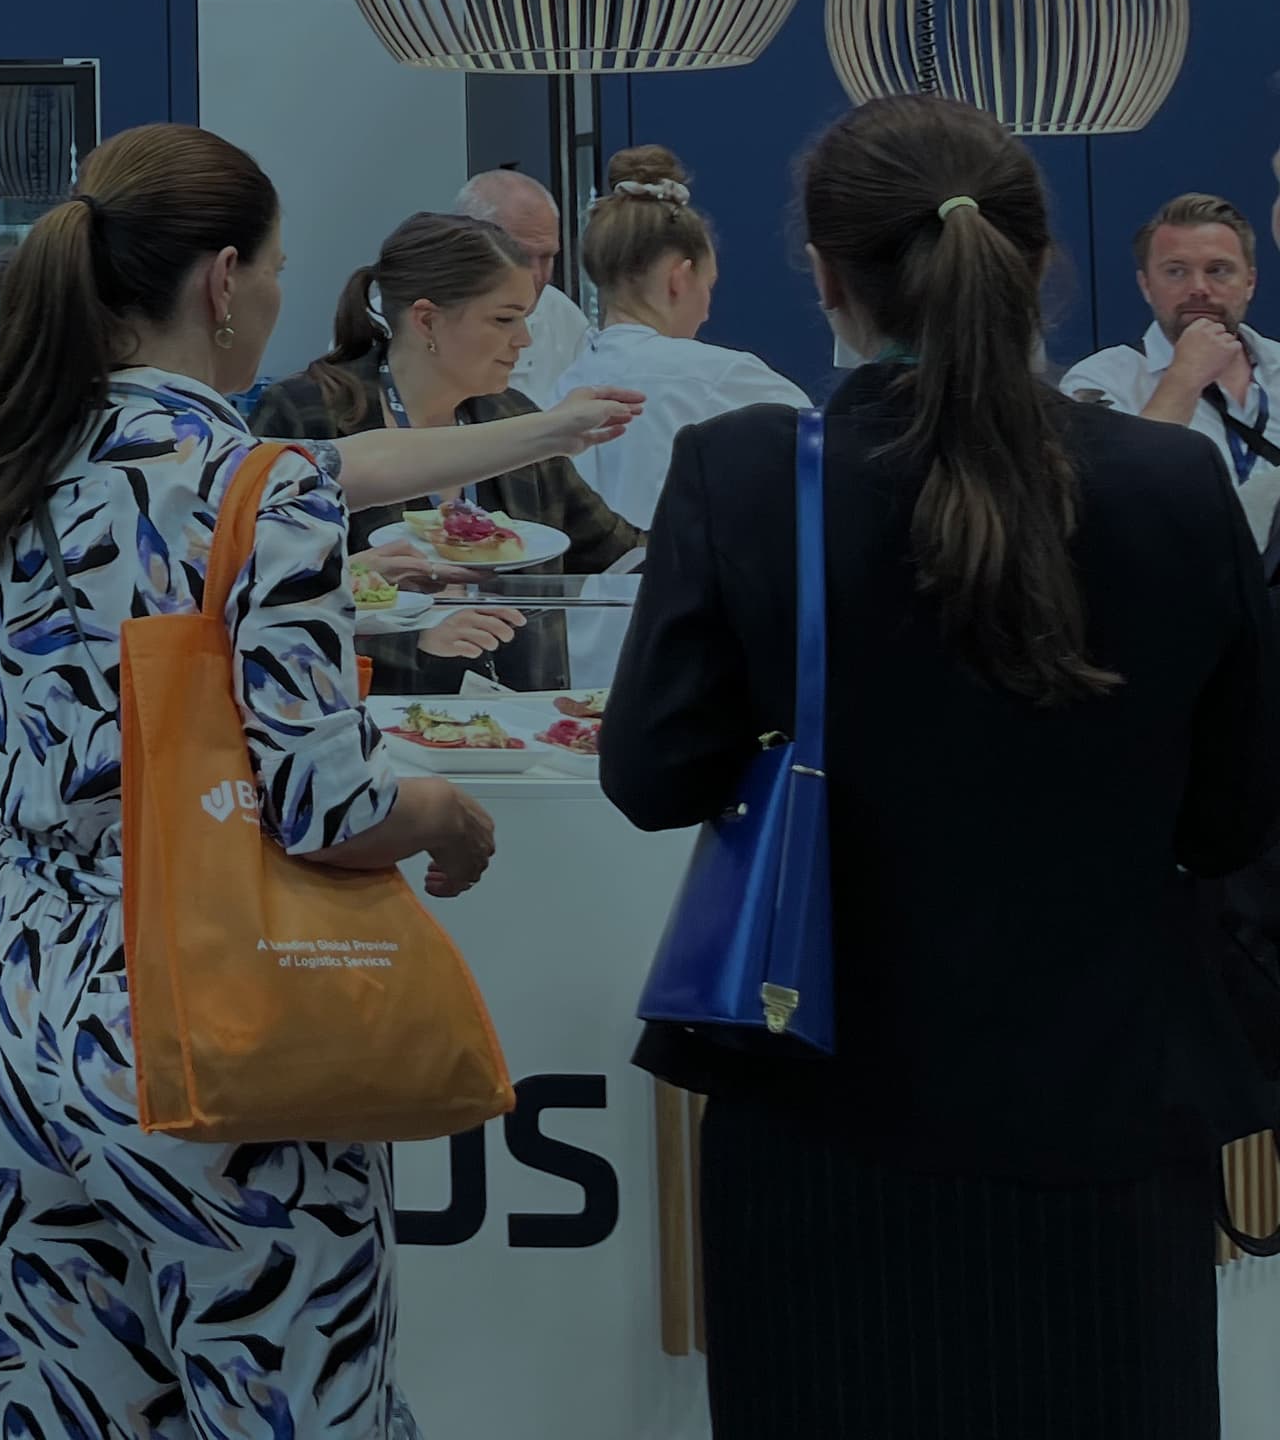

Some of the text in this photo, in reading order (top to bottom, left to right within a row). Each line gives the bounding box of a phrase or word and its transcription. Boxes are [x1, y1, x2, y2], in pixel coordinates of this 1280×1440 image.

[256, 938, 399, 952] A Leading Global Provider
[279, 955, 392, 968] of Logistics Services
